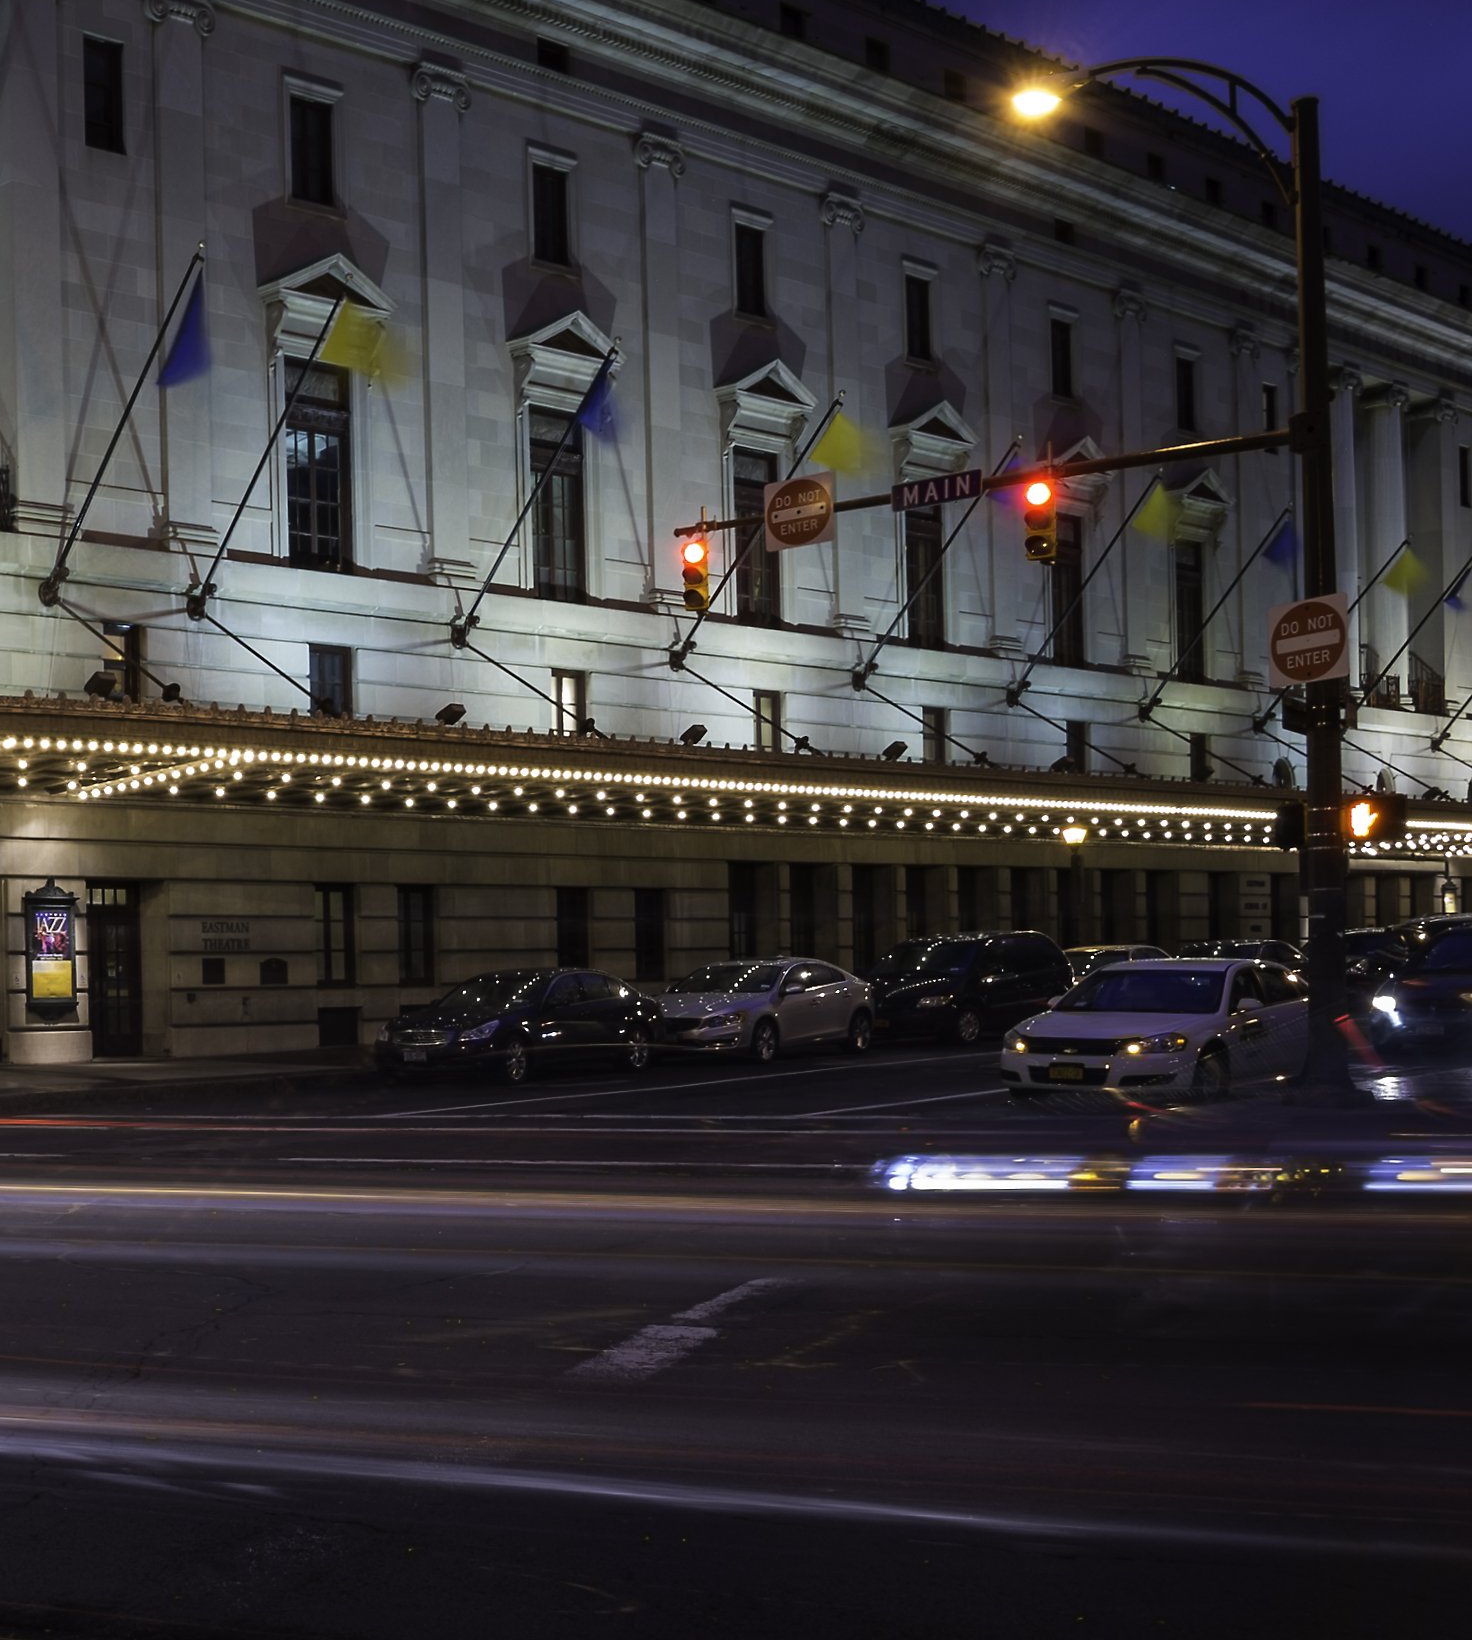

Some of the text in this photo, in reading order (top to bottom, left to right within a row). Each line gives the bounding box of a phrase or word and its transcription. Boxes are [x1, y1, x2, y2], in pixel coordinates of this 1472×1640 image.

[775, 489, 821, 509] DO NOT
[903, 475, 970, 507] MAIN
[780, 519, 819, 537] ENTER
[1280, 613, 1335, 637] DO NOT
[1286, 649, 1331, 669] ENTER
[36, 916, 67, 934] JAZZ
[201, 920, 250, 934] EASTMAN
[201, 938, 251, 951] THEATRE
